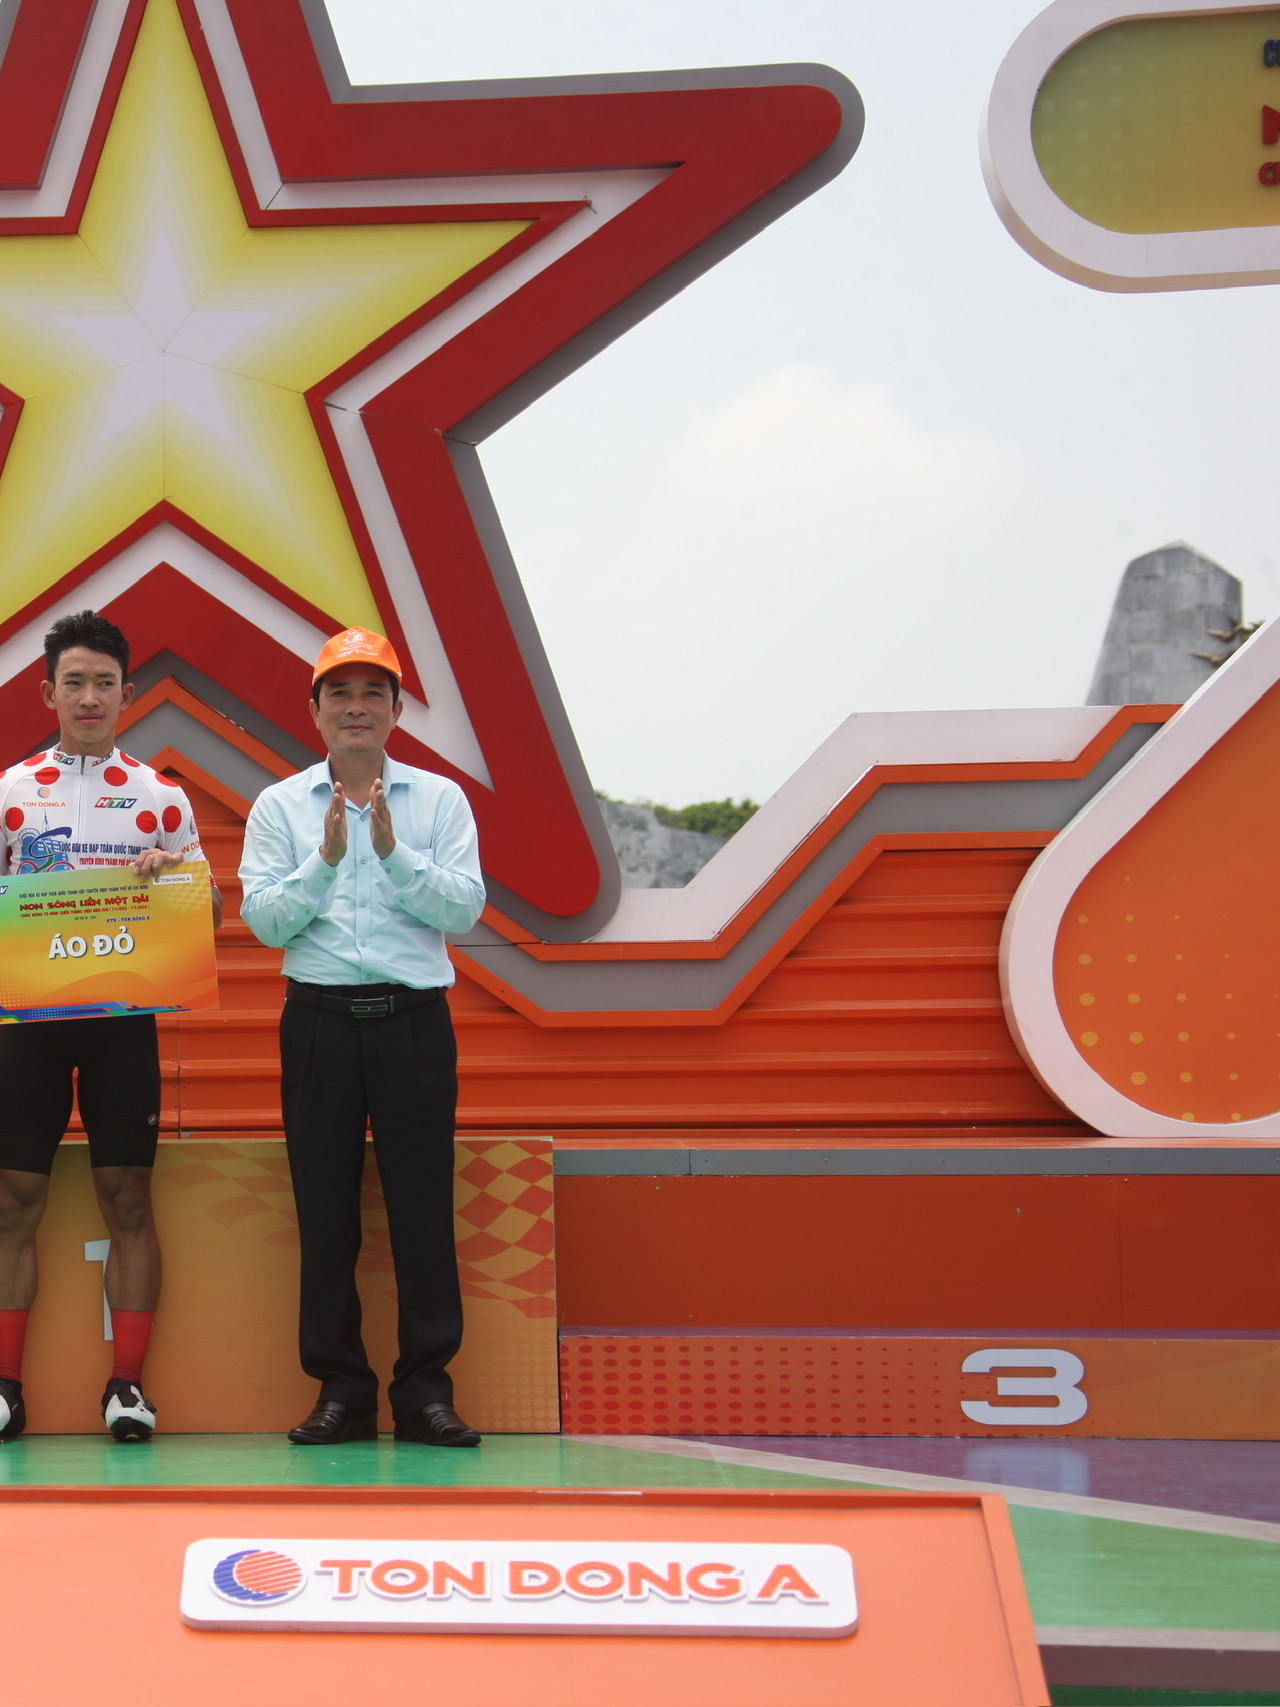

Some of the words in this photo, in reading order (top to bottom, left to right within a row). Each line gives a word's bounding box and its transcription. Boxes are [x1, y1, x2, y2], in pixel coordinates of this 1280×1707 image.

[95, 798, 136, 808] HTV
[19, 903, 43, 911] NON
[47, 900, 76, 909] SÔNG
[80, 896, 101, 907] LIỀN
[104, 896, 128, 906] MỘT
[48, 933, 87, 959] ÁO
[92, 925, 135, 956] ĐỎ
[960, 1348, 1088, 1426] 3
[320, 1558, 486, 1597] TON
[508, 1560, 743, 1599] DONG
[755, 1563, 820, 1598] A
